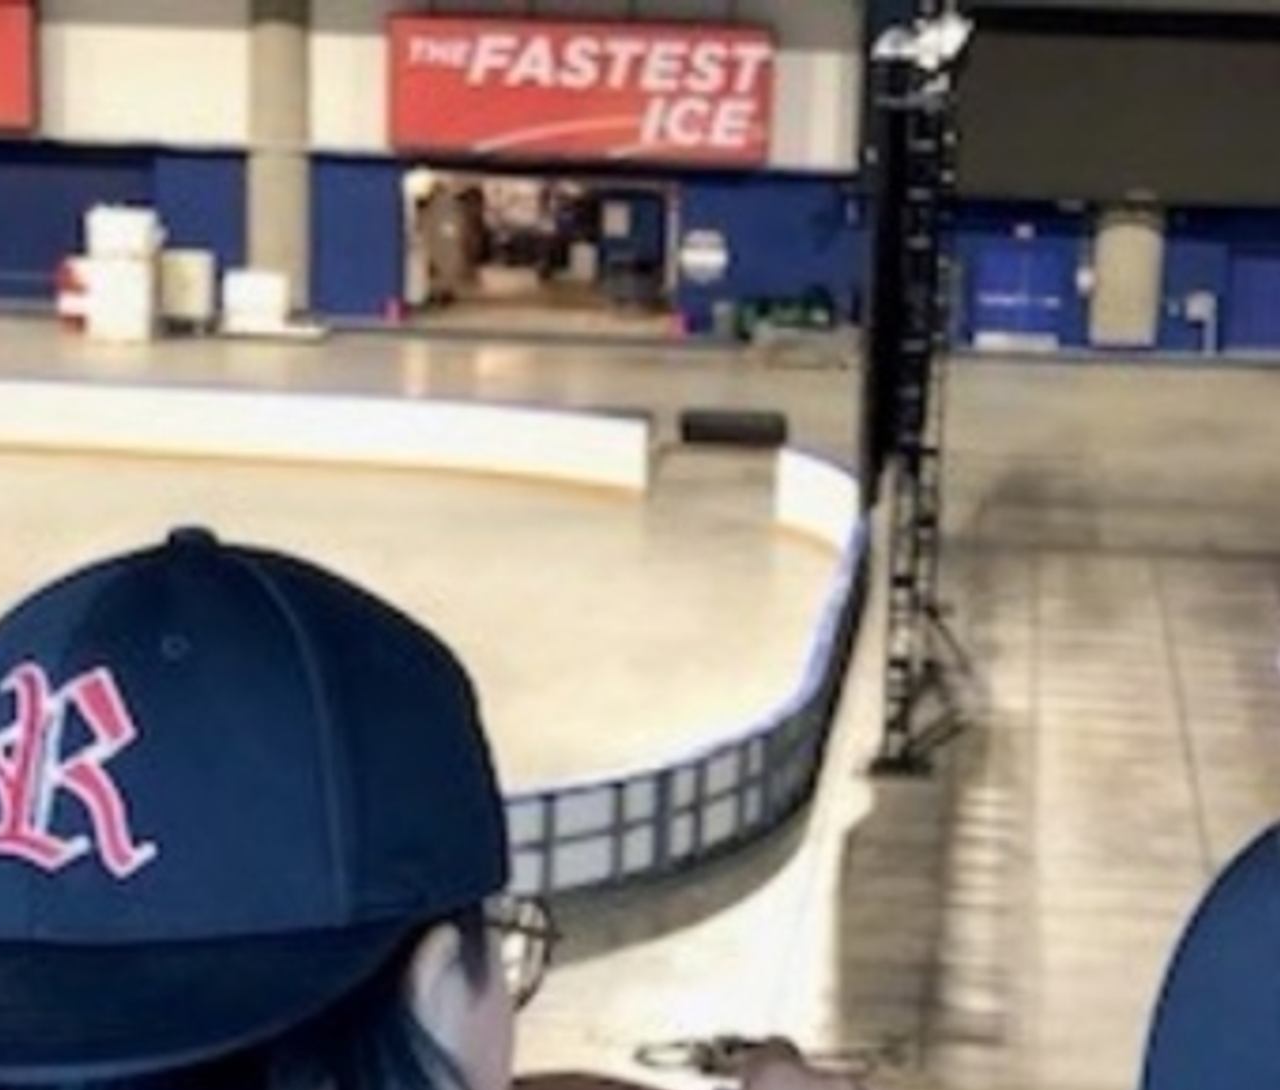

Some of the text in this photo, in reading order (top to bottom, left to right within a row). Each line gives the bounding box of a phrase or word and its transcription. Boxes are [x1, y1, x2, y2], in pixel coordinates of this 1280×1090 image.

[408, 34, 773, 93] THE FASTEST
[641, 97, 756, 146] ICE
